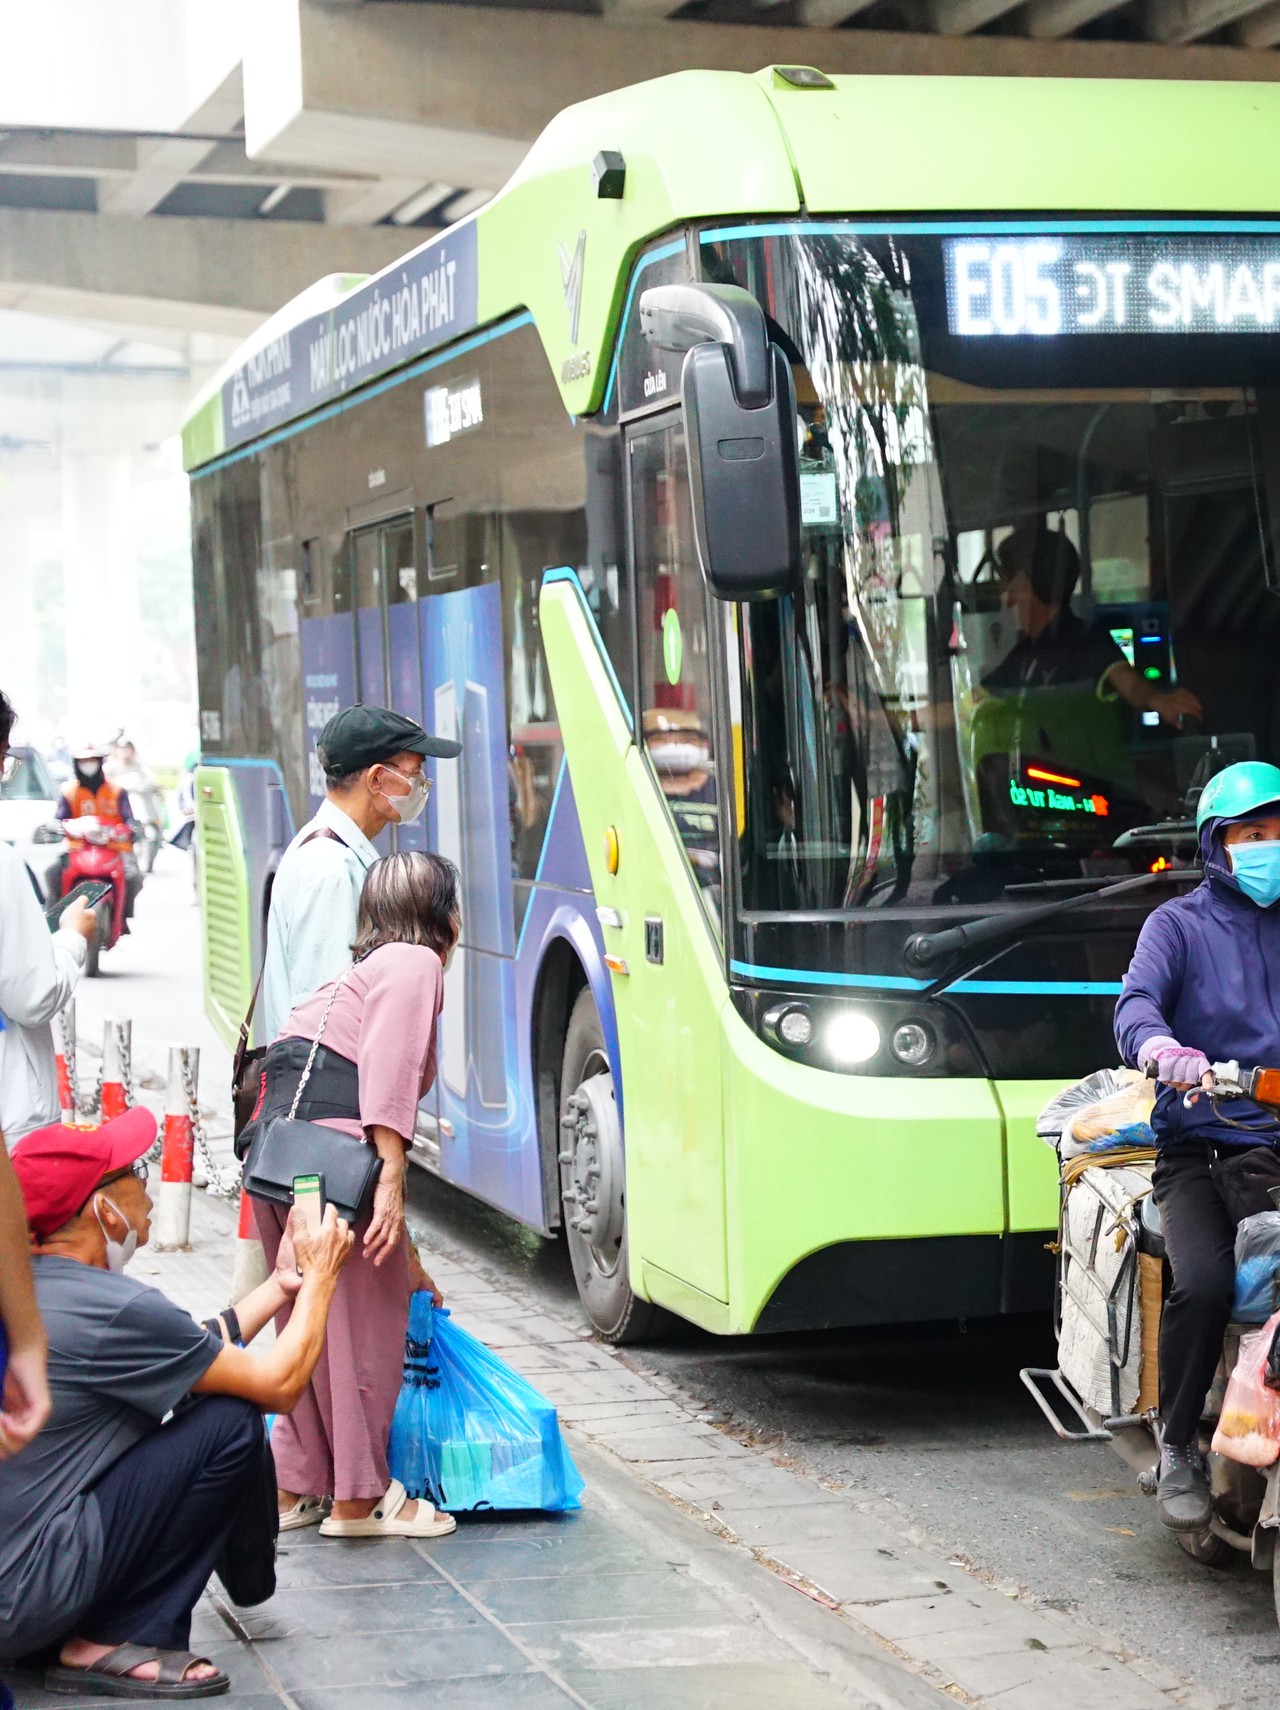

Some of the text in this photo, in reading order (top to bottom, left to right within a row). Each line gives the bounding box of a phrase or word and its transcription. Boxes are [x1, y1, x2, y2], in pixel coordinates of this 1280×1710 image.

[391, 272, 421, 349] HÒA
[420, 249, 457, 335] PHÁT
[954, 244, 1063, 335] E05
